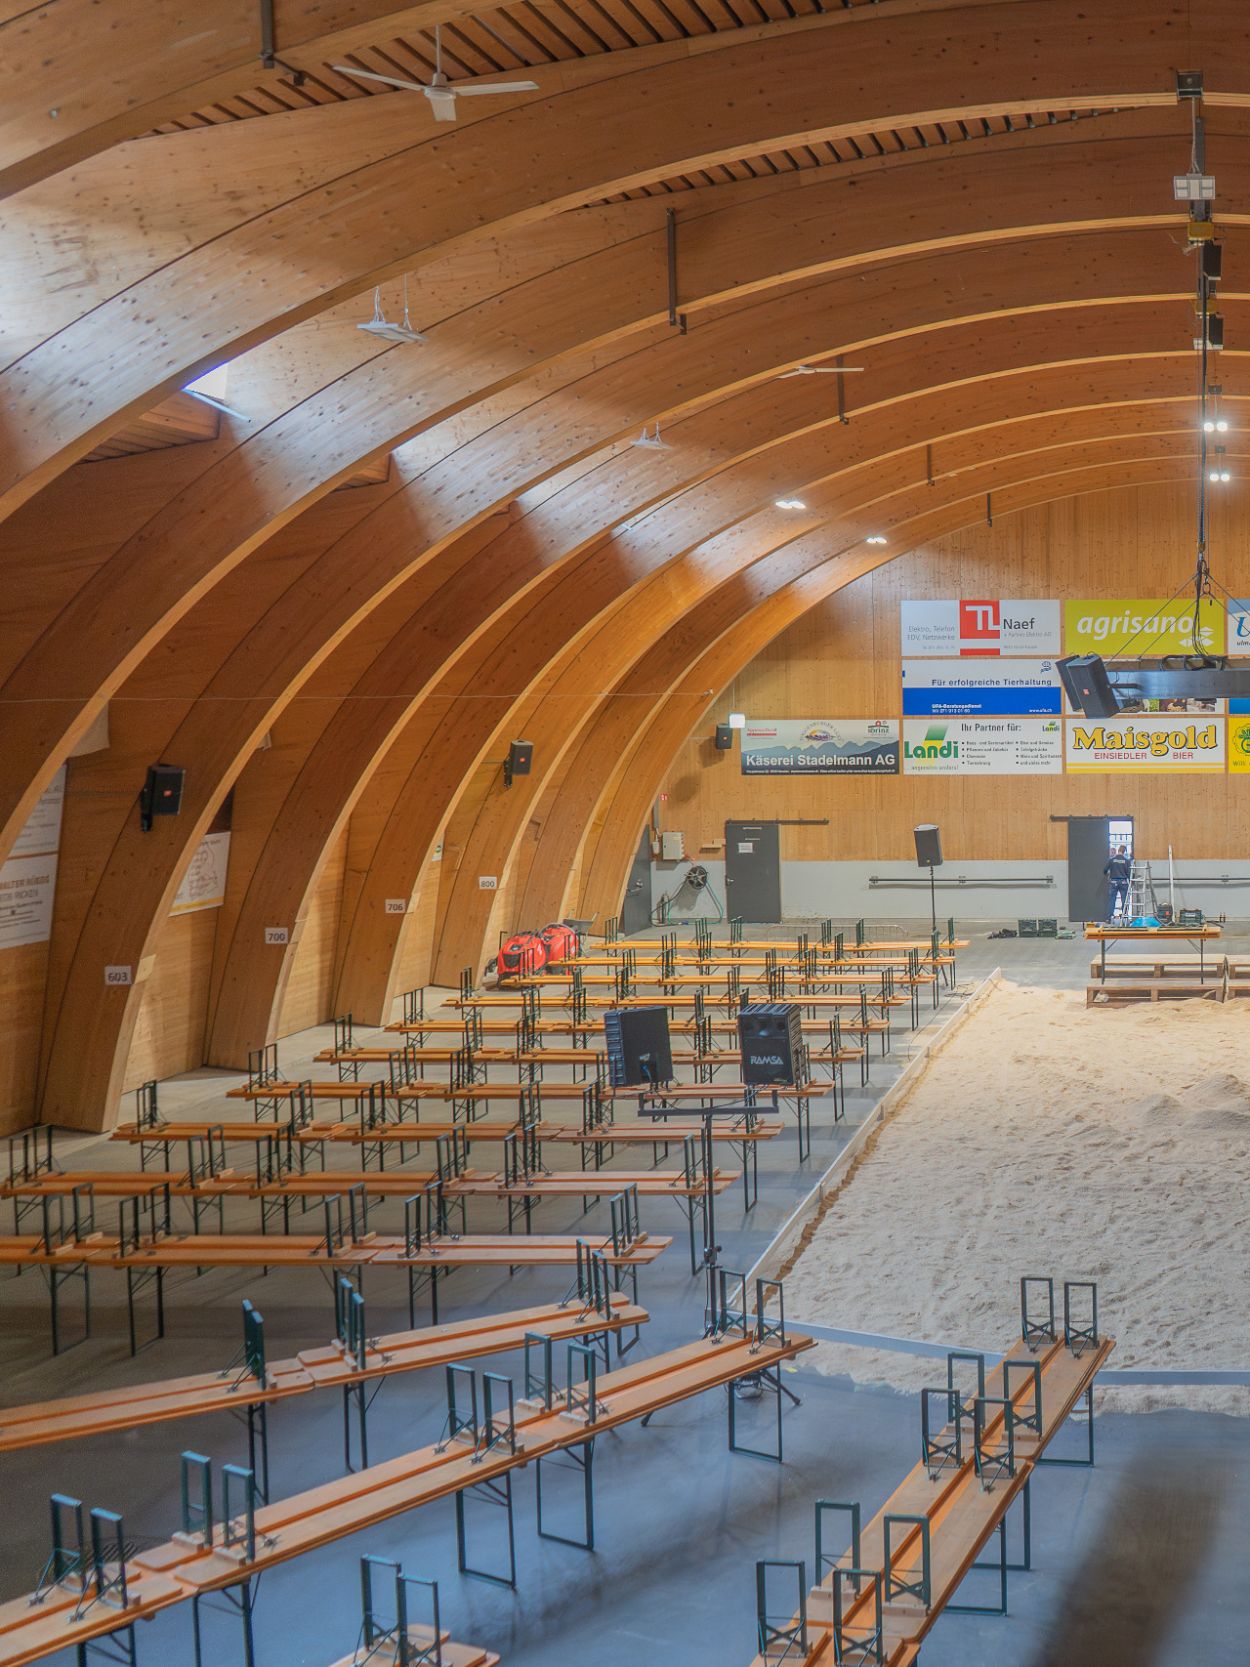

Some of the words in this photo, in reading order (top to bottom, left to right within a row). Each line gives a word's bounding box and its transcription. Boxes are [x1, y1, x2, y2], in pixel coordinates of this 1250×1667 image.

[1003, 617, 1035, 630] Naef
[1077, 609, 1194, 641] agrisano
[931, 678, 946, 686] Für
[948, 678, 1001, 688] erfolgreiche
[1003, 677, 1052, 687] Tierhaltung
[961, 723, 972, 732] Ihr
[974, 723, 1004, 732] Partner
[1007, 723, 1022, 732] für:
[1072, 724, 1218, 757] Maisgold
[904, 741, 959, 759] Landi
[746, 754, 794, 766] Käserei
[797, 754, 872, 766] Stadelmann
[875, 754, 896, 766] AG
[1094, 752, 1148, 760] EINSIEDLER
[480, 880, 495, 888] 800
[268, 932, 286, 942] 700
[108, 971, 128, 983] 603
[750, 1055, 784, 1065] RAMSA
